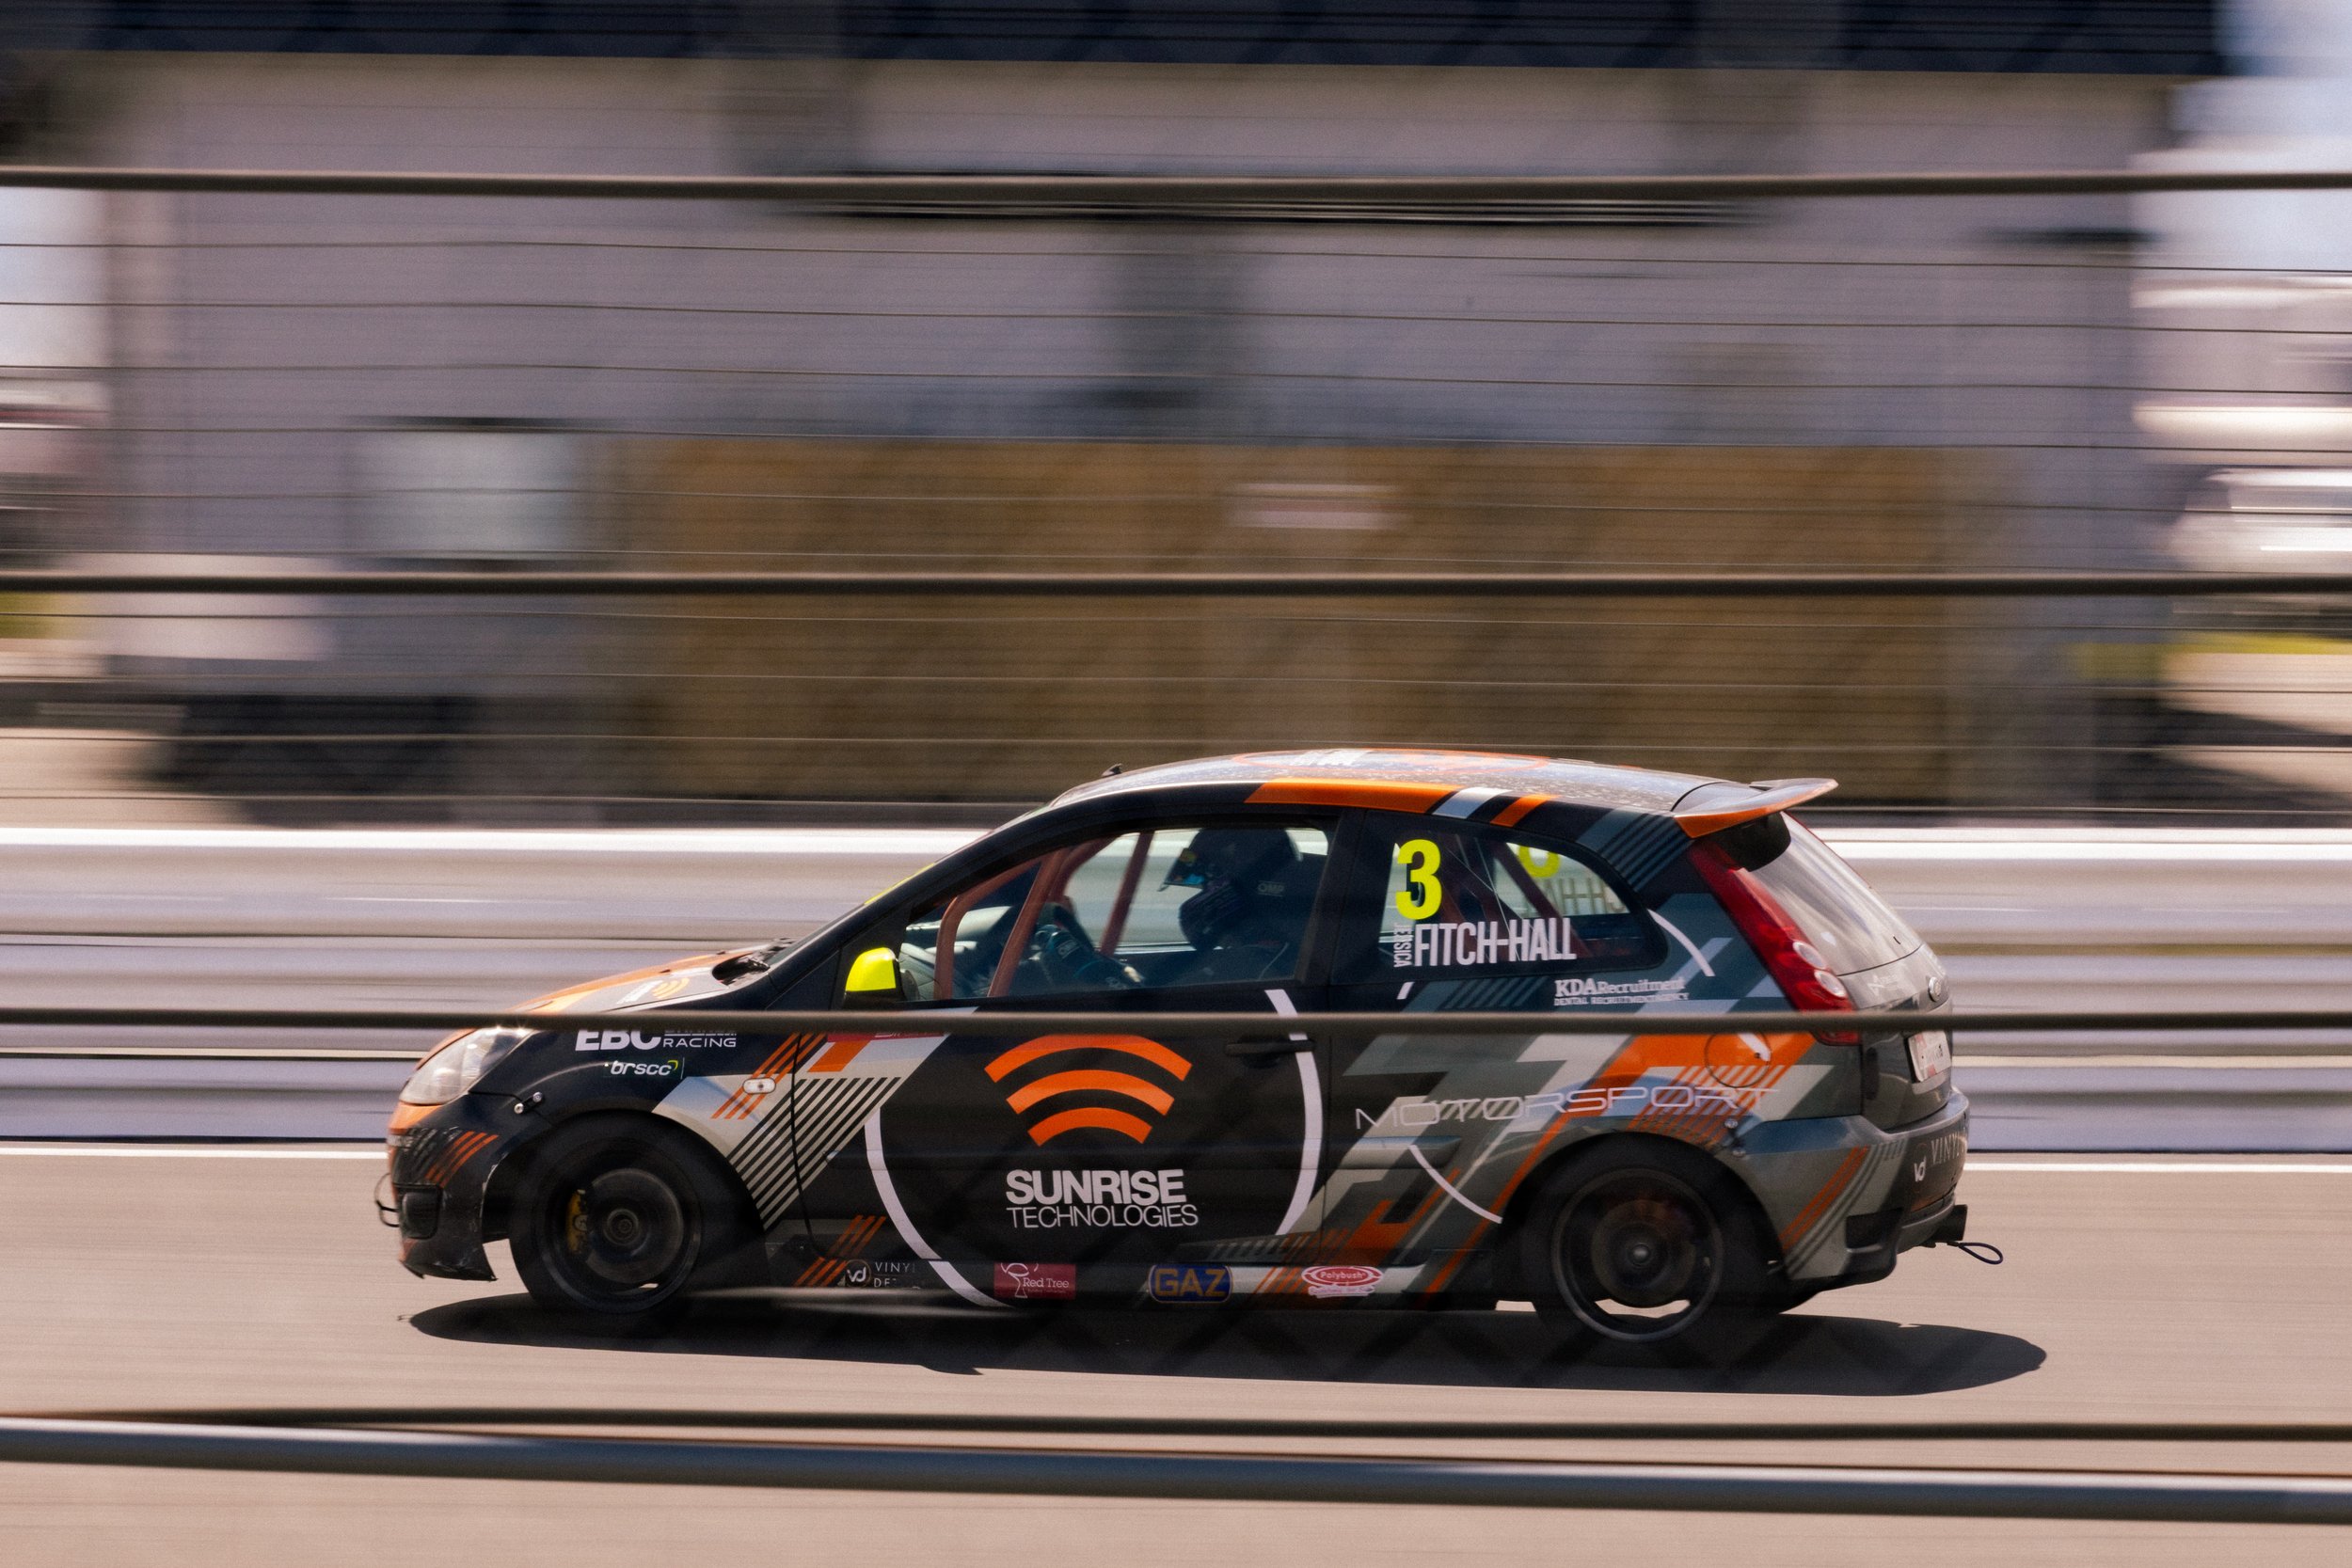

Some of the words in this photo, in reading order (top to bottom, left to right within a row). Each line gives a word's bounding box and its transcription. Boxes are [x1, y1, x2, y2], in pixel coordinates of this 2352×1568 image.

[1395, 839, 1442, 920] 3
[1414, 917, 1578, 967] FITCH-HALL
[575, 1029, 661, 1052] EBC
[662, 1037, 737, 1049] RACING
[611, 1060, 672, 1076] brscc
[1355, 1085, 1780, 1130] MOTORSPORT
[1006, 1169, 1187, 1206] SUNRISE
[1006, 1204, 1200, 1228] TECHNOLOGIES
[1023, 1277, 1044, 1288] Red
[1046, 1277, 1070, 1289] Tree
[1155, 1268, 1226, 1297] GAZ
